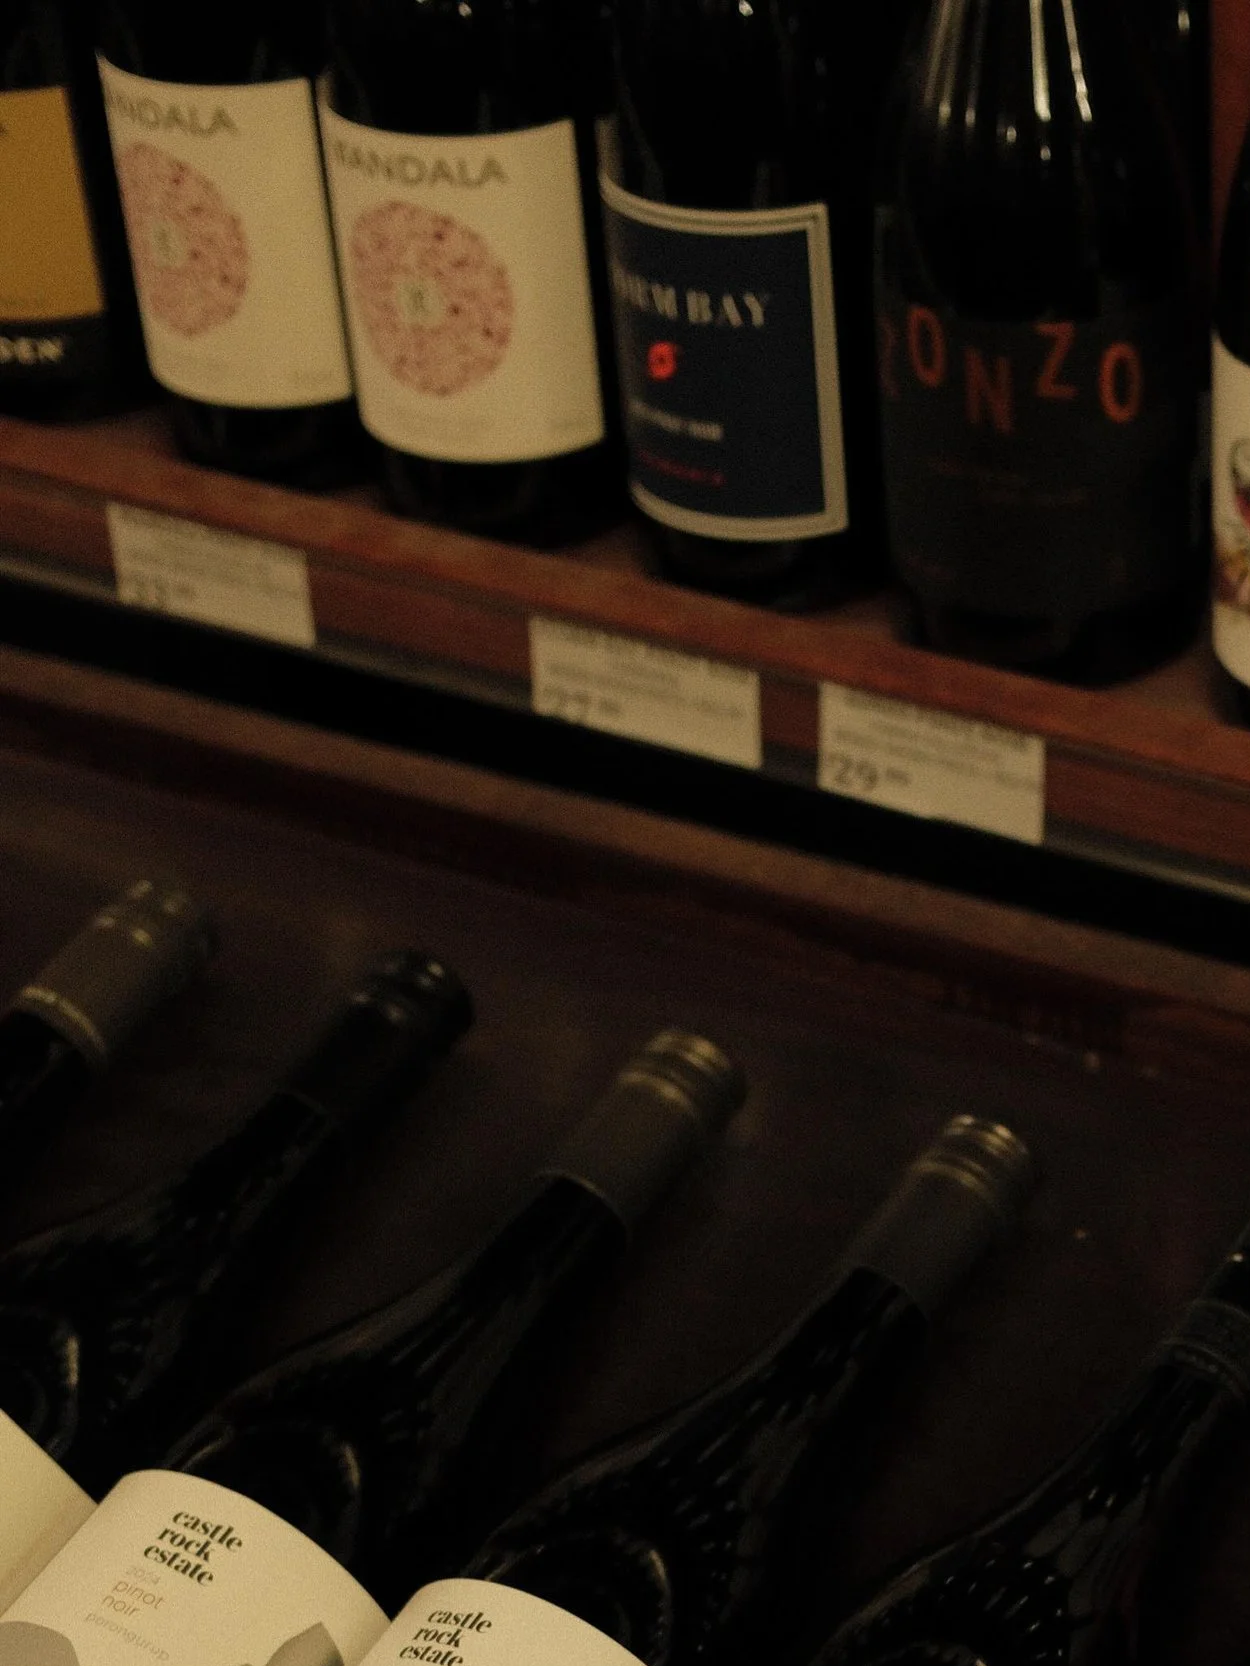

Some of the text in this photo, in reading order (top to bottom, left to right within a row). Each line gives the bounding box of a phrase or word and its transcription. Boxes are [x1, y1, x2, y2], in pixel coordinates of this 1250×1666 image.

[158, 1527, 212, 1562] rock
[172, 1511, 243, 1551] castle
[143, 1545, 214, 1587] estate
[101, 1594, 140, 1617] noir
[111, 1580, 165, 1610] pinot
[427, 1609, 493, 1634] castle
[413, 1627, 463, 1648] rock
